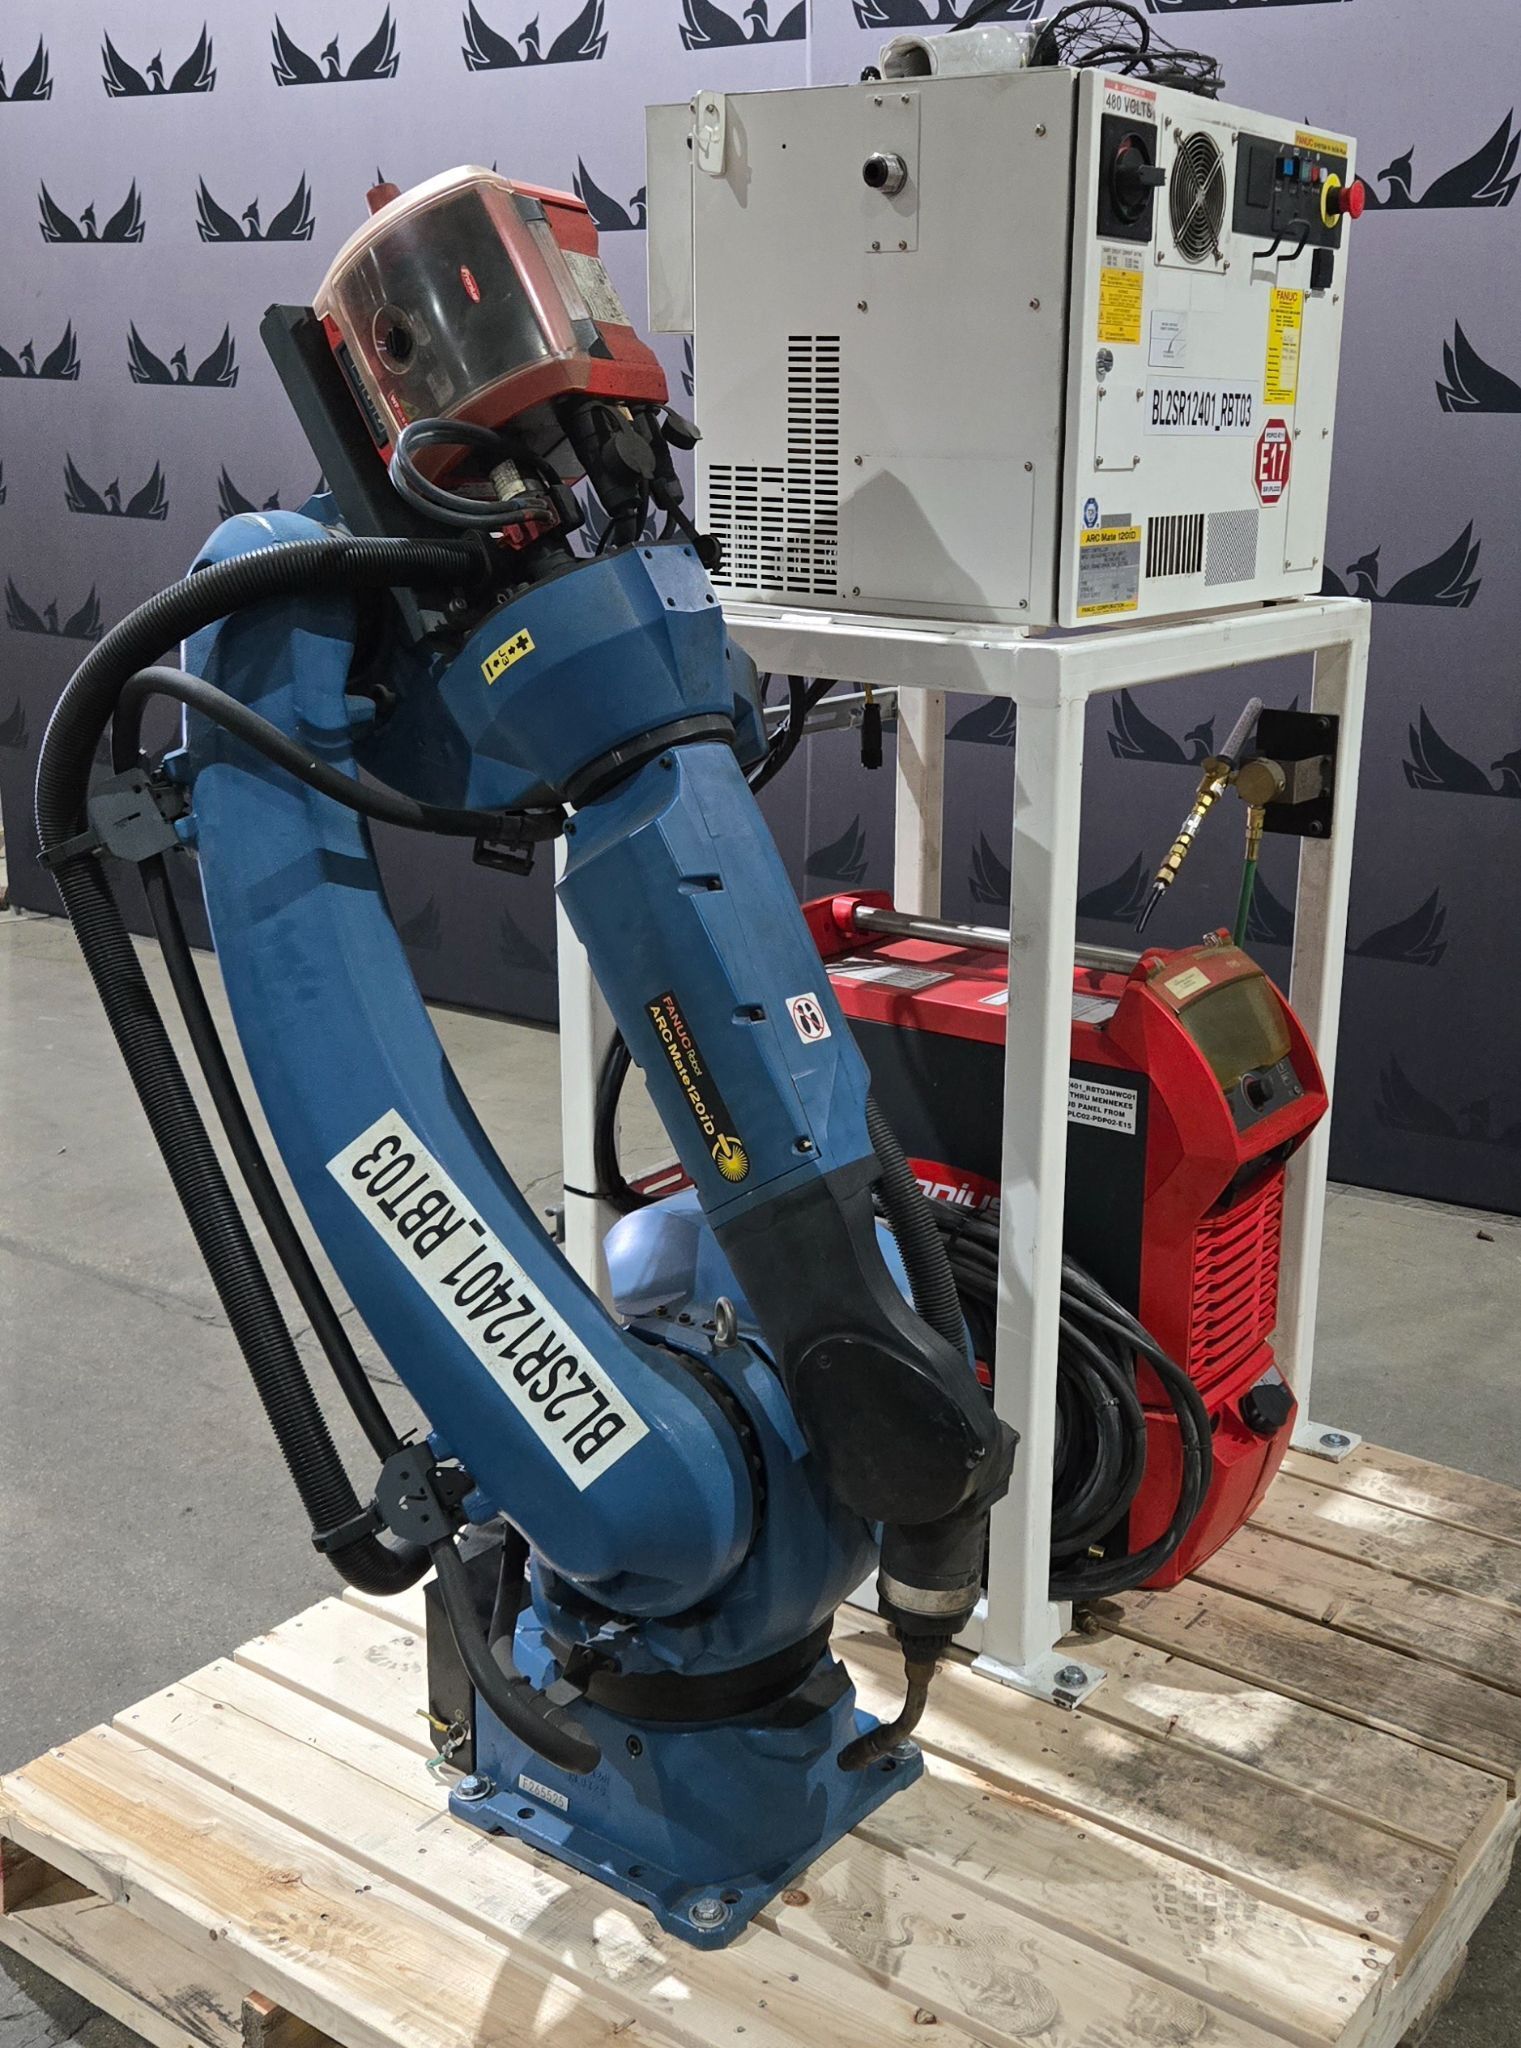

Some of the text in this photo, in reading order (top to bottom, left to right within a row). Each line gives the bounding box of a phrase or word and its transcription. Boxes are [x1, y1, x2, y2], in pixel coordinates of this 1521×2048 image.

[1106, 93, 1153, 119] 480 VOLTS
[1277, 290, 1298, 302] FANUC
[1151, 389, 1252, 432] BL2SR12401_RBT03
[1259, 442, 1287, 480] E17
[1086, 533, 1100, 543] ARC
[650, 1006, 673, 1044] ARC
[668, 1043, 691, 1087] Mate
[662, 995, 703, 1077] FANUC Robot
[1068, 1082, 1136, 1101] 401_RBT03MWC01
[1069, 1091, 1133, 1110] THRU MENNEKES
[1067, 1110, 1132, 1129] PLC02-PDP02-E15
[1078, 1102, 1102, 1113] PANEL
[1104, 1107, 1126, 1118] FROM
[351, 1134, 626, 1465] BL2SR12401_RBT03
[522, 1777, 565, 1808] F265525
